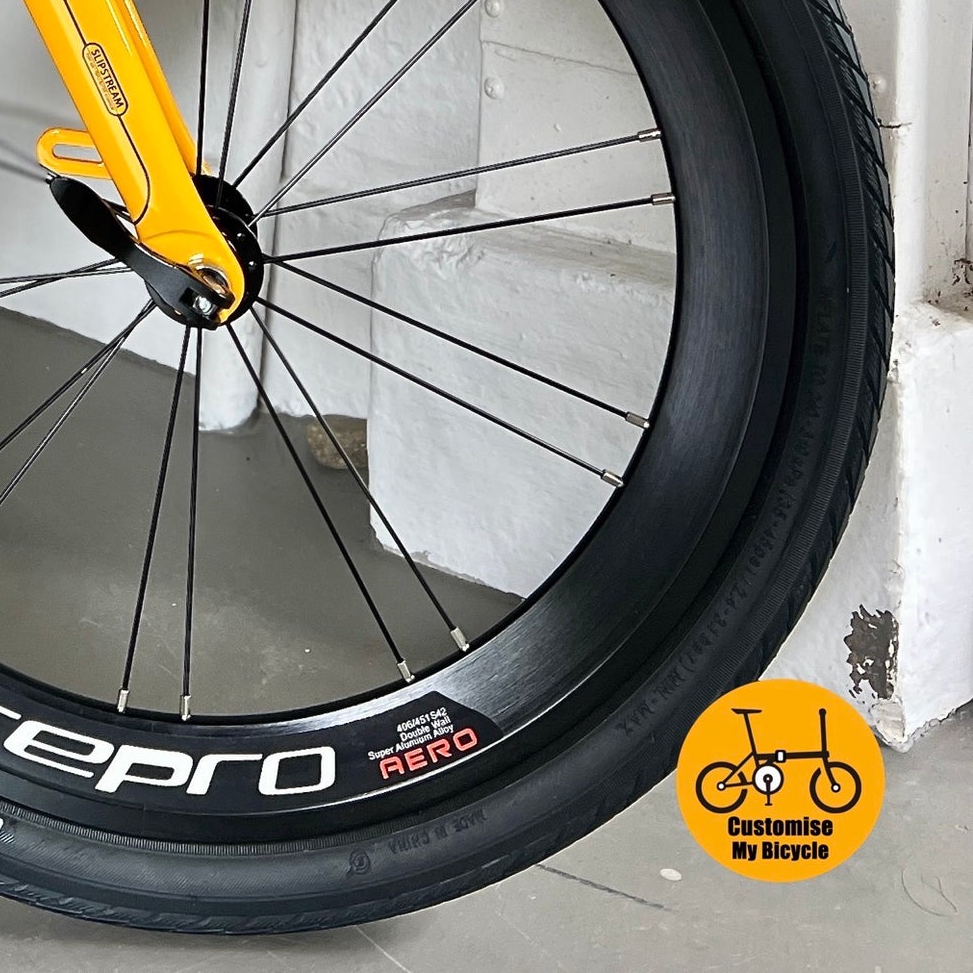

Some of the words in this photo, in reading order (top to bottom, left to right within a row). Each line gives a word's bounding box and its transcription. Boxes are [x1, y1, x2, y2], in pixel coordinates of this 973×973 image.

[91, 49, 124, 108] SLIPSTREAM
[396, 713, 430, 733] 406/451
[399, 725, 431, 742] Double
[431, 716, 452, 729] Wall
[367, 746, 394, 761] Super
[433, 724, 454, 738] Alloy
[379, 727, 478, 780] AERO
